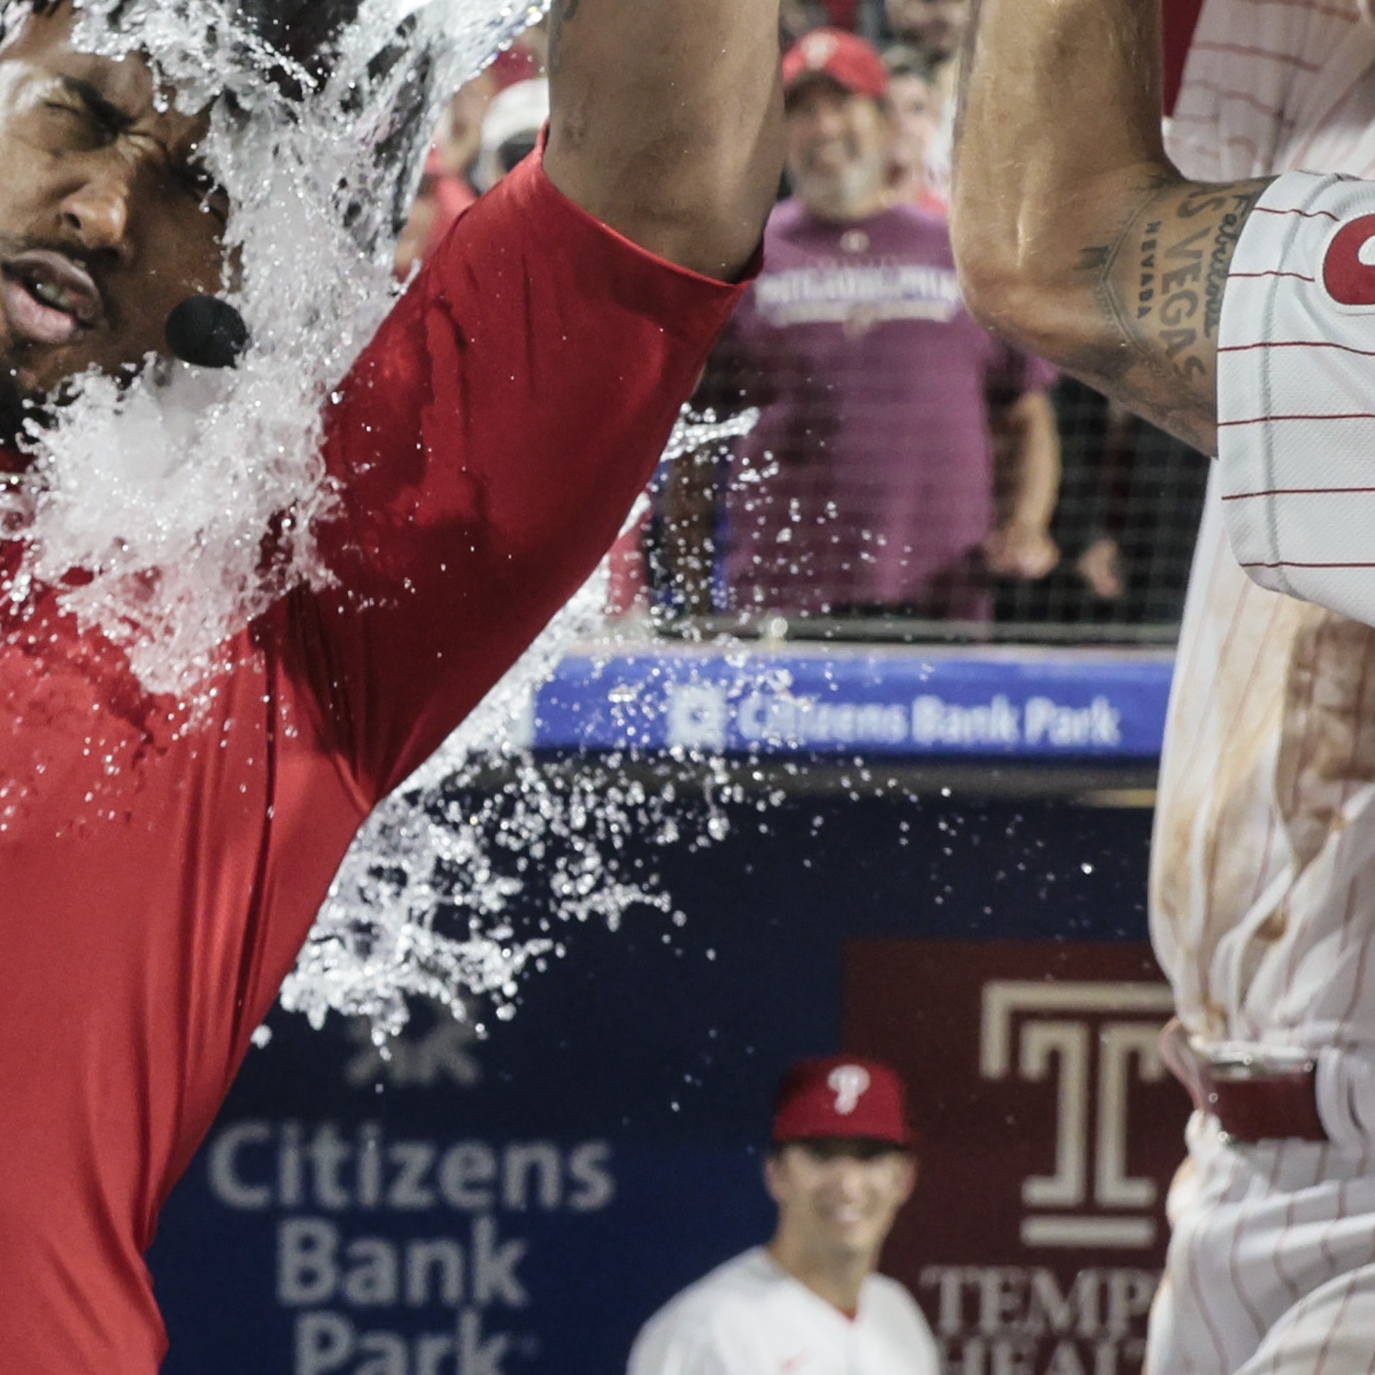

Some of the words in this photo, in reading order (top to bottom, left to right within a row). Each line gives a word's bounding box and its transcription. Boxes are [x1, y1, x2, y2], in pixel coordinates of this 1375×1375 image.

[1135, 220, 1162, 320] NEVADA
[1158, 226, 1212, 382] VEGAS
[912, 692, 1021, 747] Bank
[1025, 693, 1121, 747] Park
[208, 1119, 616, 1213] Citizens
[274, 1216, 527, 1308] Bank
[292, 1309, 513, 1375] Park
